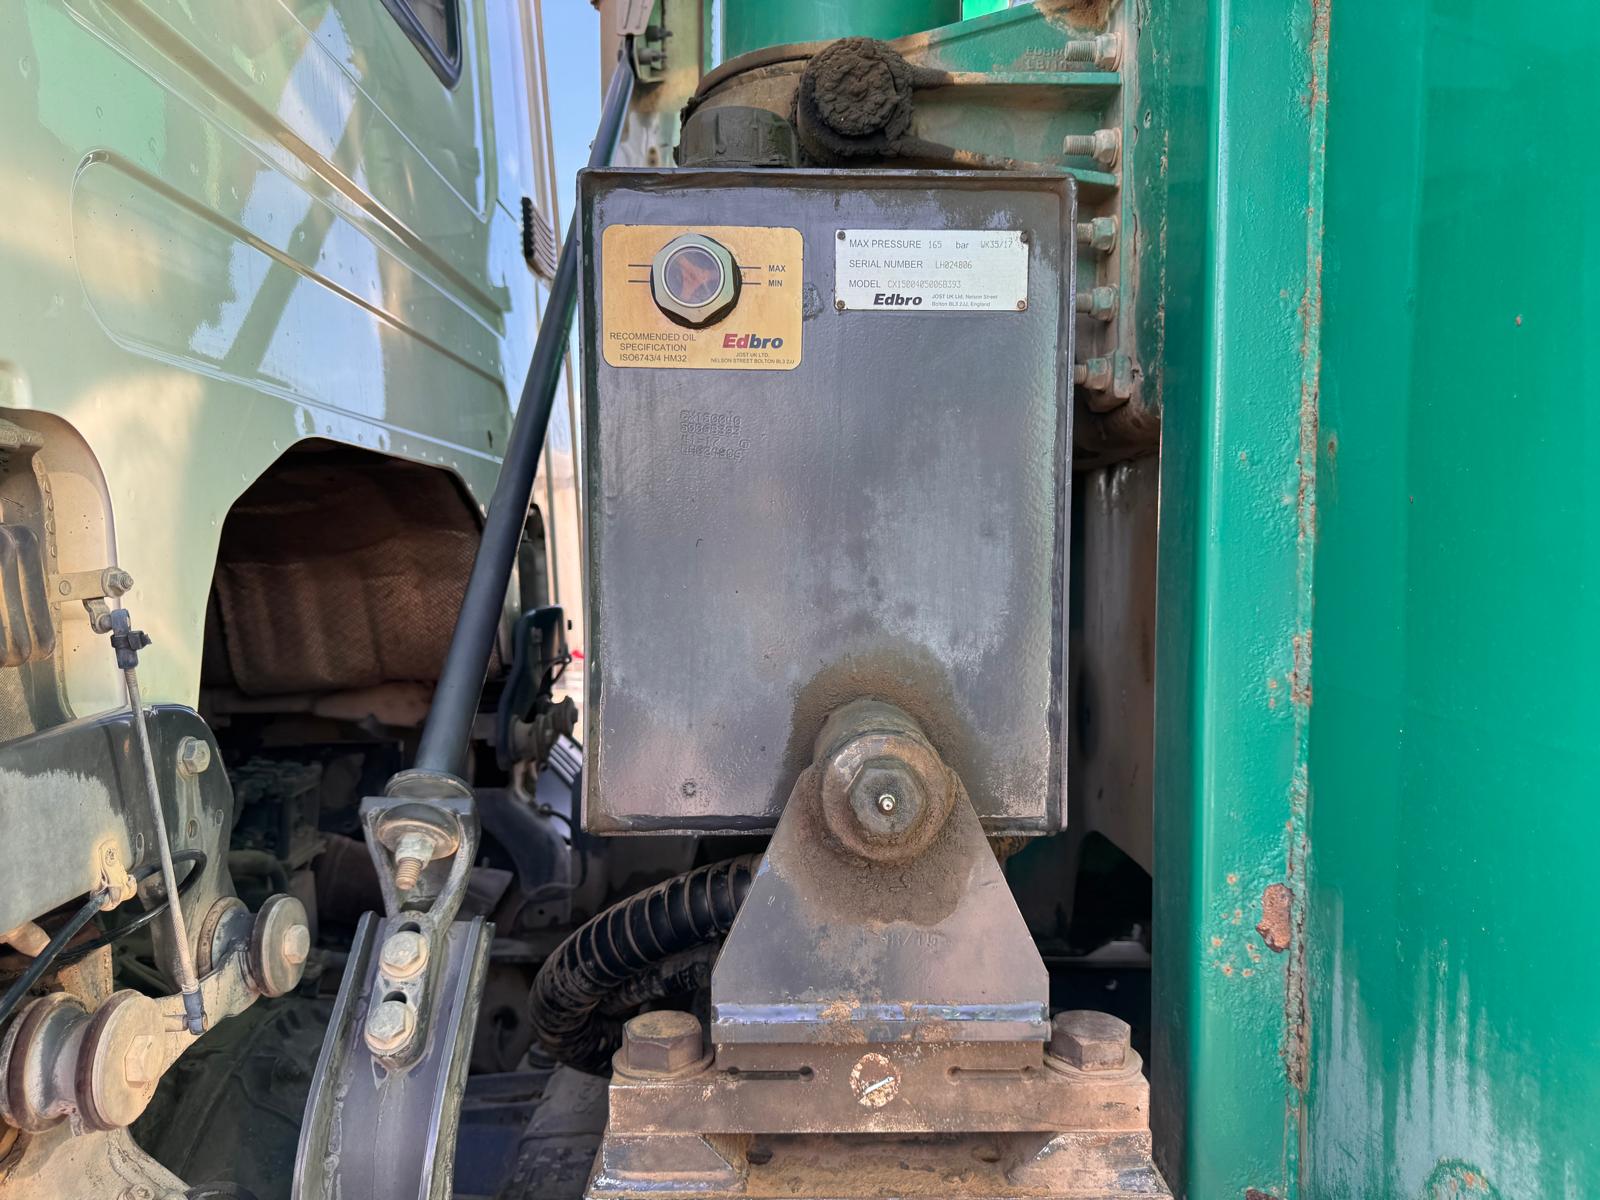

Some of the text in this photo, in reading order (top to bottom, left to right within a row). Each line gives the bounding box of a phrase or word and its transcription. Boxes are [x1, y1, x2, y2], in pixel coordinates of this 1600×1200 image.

[849, 239, 870, 248] MAX
[872, 240, 922, 249] PRESSURE
[928, 240, 942, 249] 165
[955, 240, 970, 249] bar
[768, 264, 786, 273] MAX
[849, 260, 972, 270] SERIAL NUMBER LH024806
[849, 280, 881, 288] MODEL
[873, 293, 922, 306] Edbro
[610, 332, 697, 342] RECOMMENDED OIL
[722, 333, 784, 349] Edbro
[620, 343, 687, 352] SPECIFICATION
[620, 354, 687, 362] ISO6743/4 HM32
